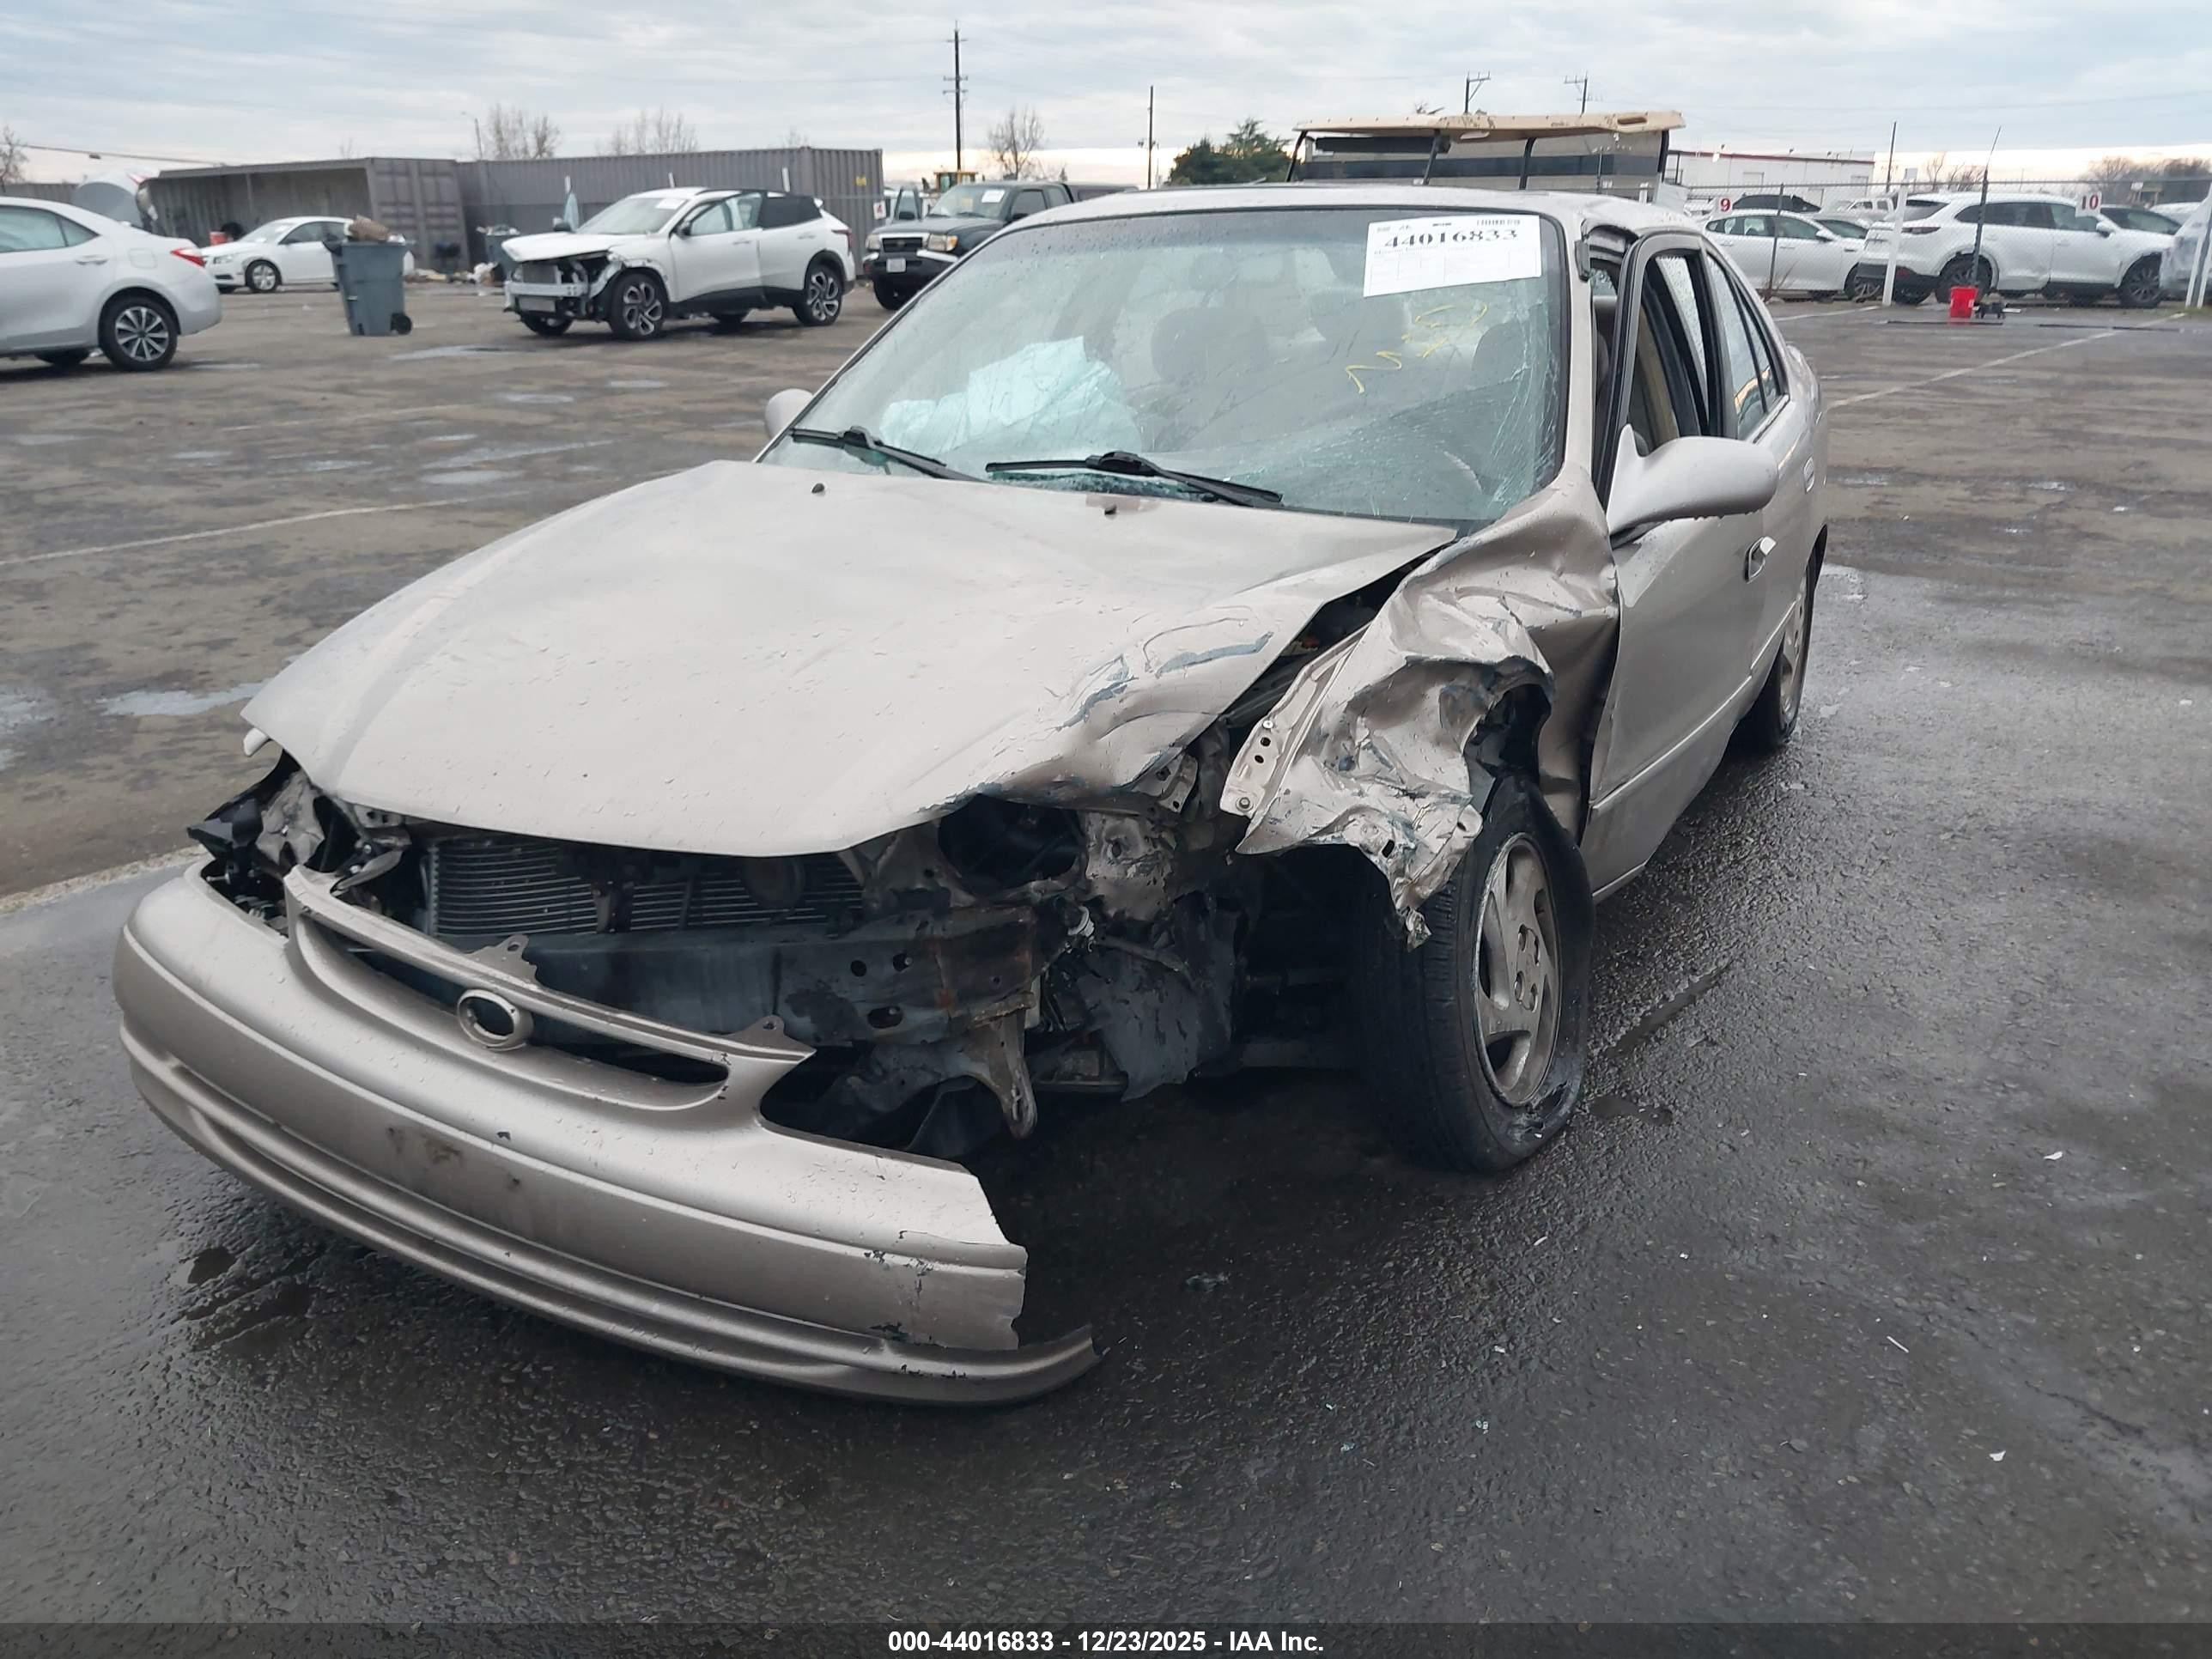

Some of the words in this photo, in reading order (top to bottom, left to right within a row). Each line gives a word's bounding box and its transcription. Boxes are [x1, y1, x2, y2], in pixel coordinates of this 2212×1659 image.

[1720, 198, 1731, 212] 9
[2081, 194, 2099, 210] 10
[1384, 228, 1518, 248] 44016833
